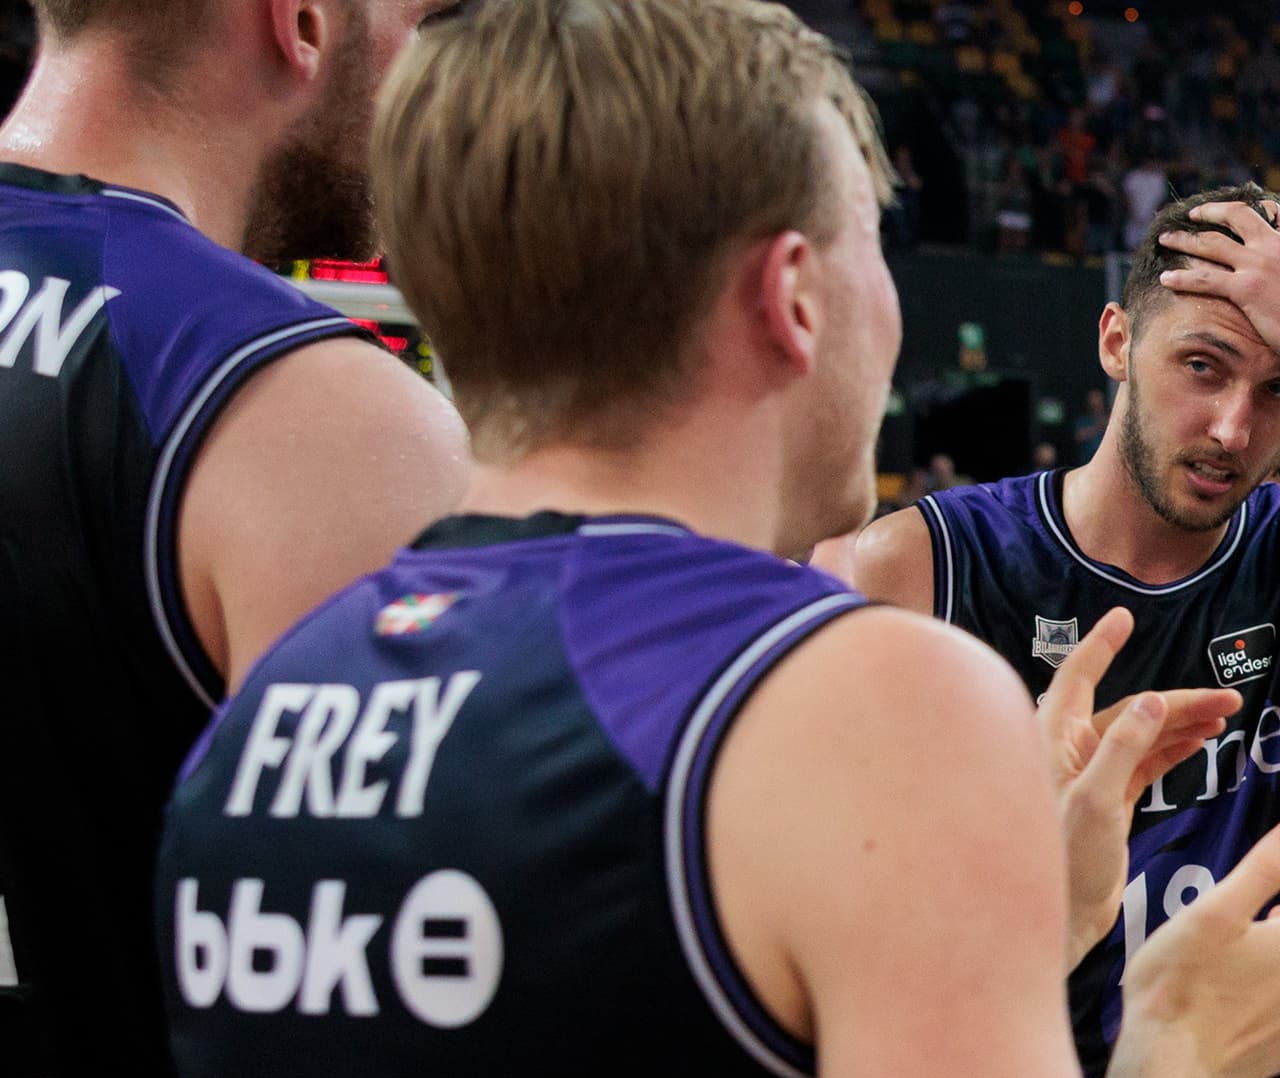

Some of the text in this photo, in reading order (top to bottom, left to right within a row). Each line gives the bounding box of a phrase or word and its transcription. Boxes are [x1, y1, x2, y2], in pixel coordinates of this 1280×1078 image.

[1217, 650, 1246, 668] liga
[225, 670, 482, 819] FREY
[175, 877, 383, 1017] bbk
